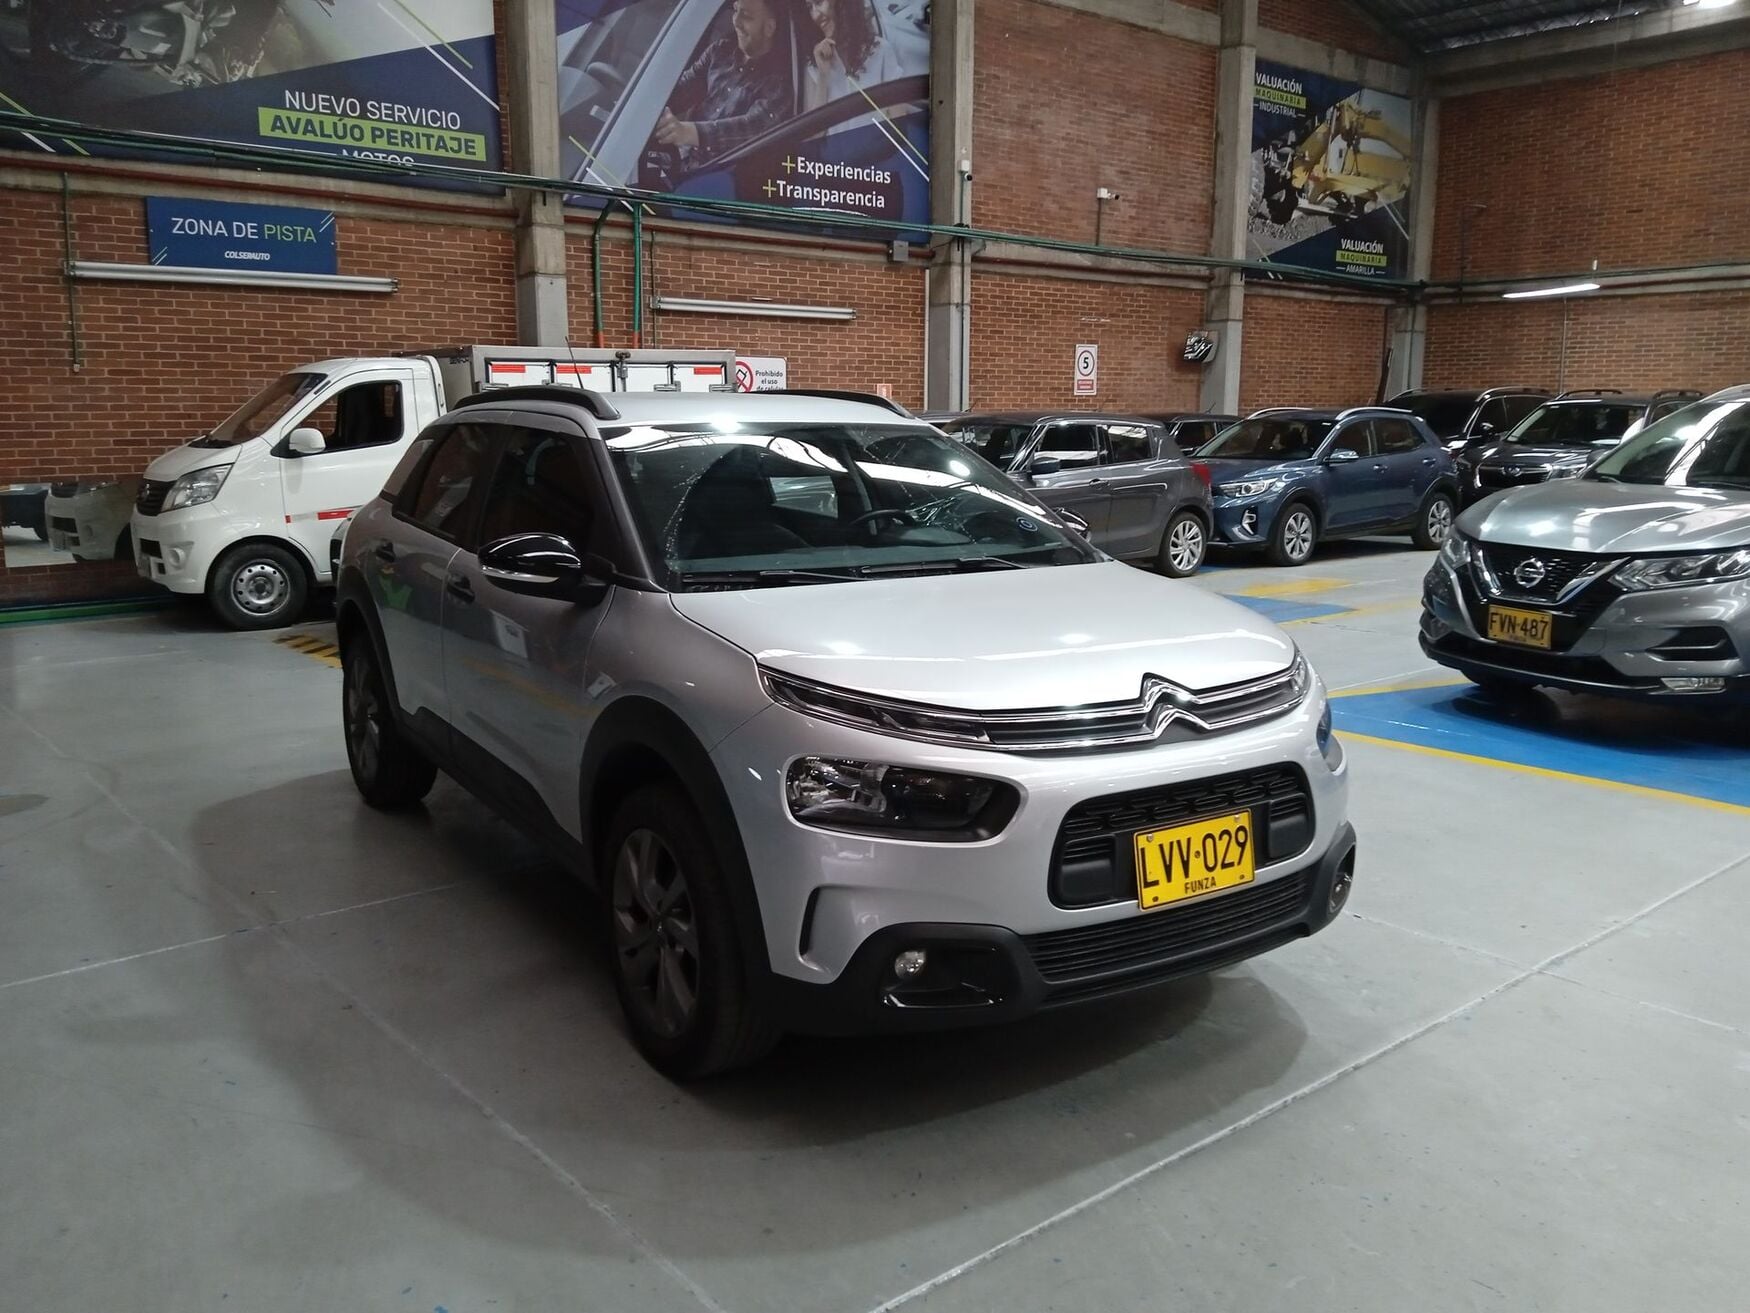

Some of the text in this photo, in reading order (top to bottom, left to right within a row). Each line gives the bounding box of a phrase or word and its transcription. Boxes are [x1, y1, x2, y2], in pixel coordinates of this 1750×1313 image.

[1255, 72, 1303, 95] VALUACIÓN
[1255, 88, 1302, 105] MAQUINARIA
[284, 90, 461, 130] NUEVO SERVICIO
[1259, 101, 1297, 118] INDUSTRIAL
[270, 115, 477, 156] AVALÚO PERITAJE
[171, 217, 318, 243] ZONA DE PISTA
[1340, 238, 1384, 254] VALUACIÓN
[1340, 252, 1382, 264] MAQUINARIA
[1345, 264, 1376, 275] AMARILLA
[1082, 356, 1090, 370] 5
[755, 369, 784, 378] Prohibido
[760, 377, 767, 385] el
[1184, 876, 1217, 894] FUNZA
